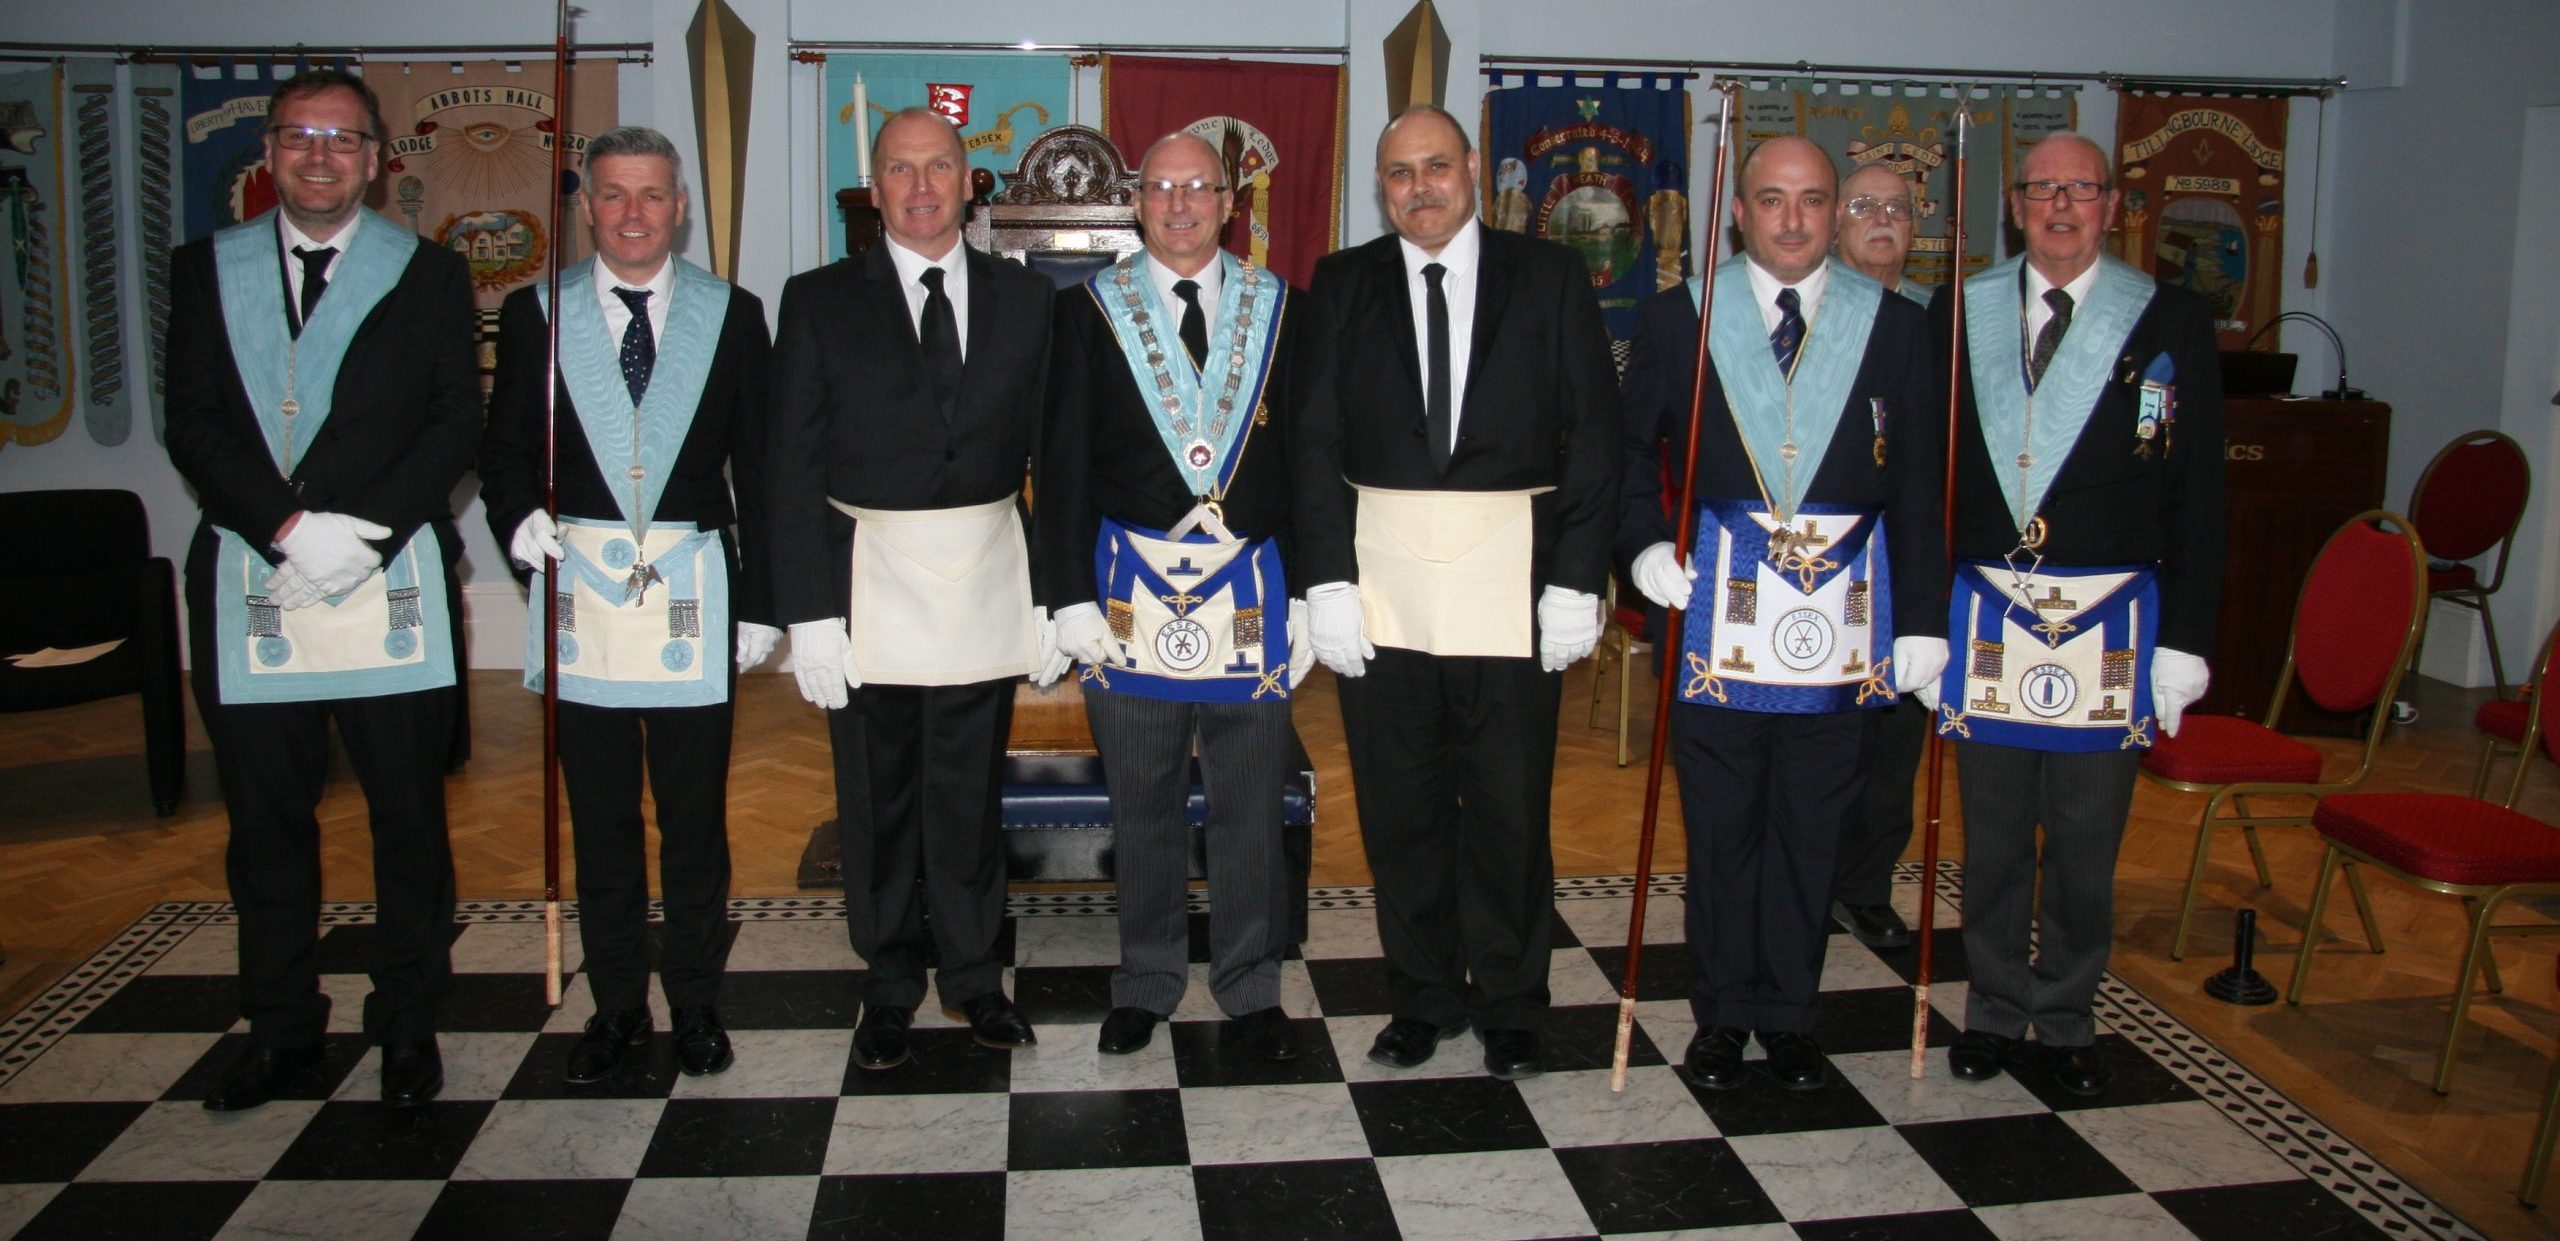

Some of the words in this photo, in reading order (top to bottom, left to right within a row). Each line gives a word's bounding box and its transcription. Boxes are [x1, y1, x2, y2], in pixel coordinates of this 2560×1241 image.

[431, 89, 493, 111] ABBOTS
[506, 89, 542, 110] HALL
[389, 136, 433, 156] LODGE
[968, 133, 1003, 149] ESSEX
[1856, 143, 1893, 162] SAINT
[2242, 133, 2280, 168] LODGE
[1887, 161, 1914, 174] ODGE
[2195, 178, 2231, 191] 5989
[1791, 610, 1820, 622] ESSEX
[1161, 620, 1202, 639] ESSEX
[2032, 665, 2071, 681] ESSEX
